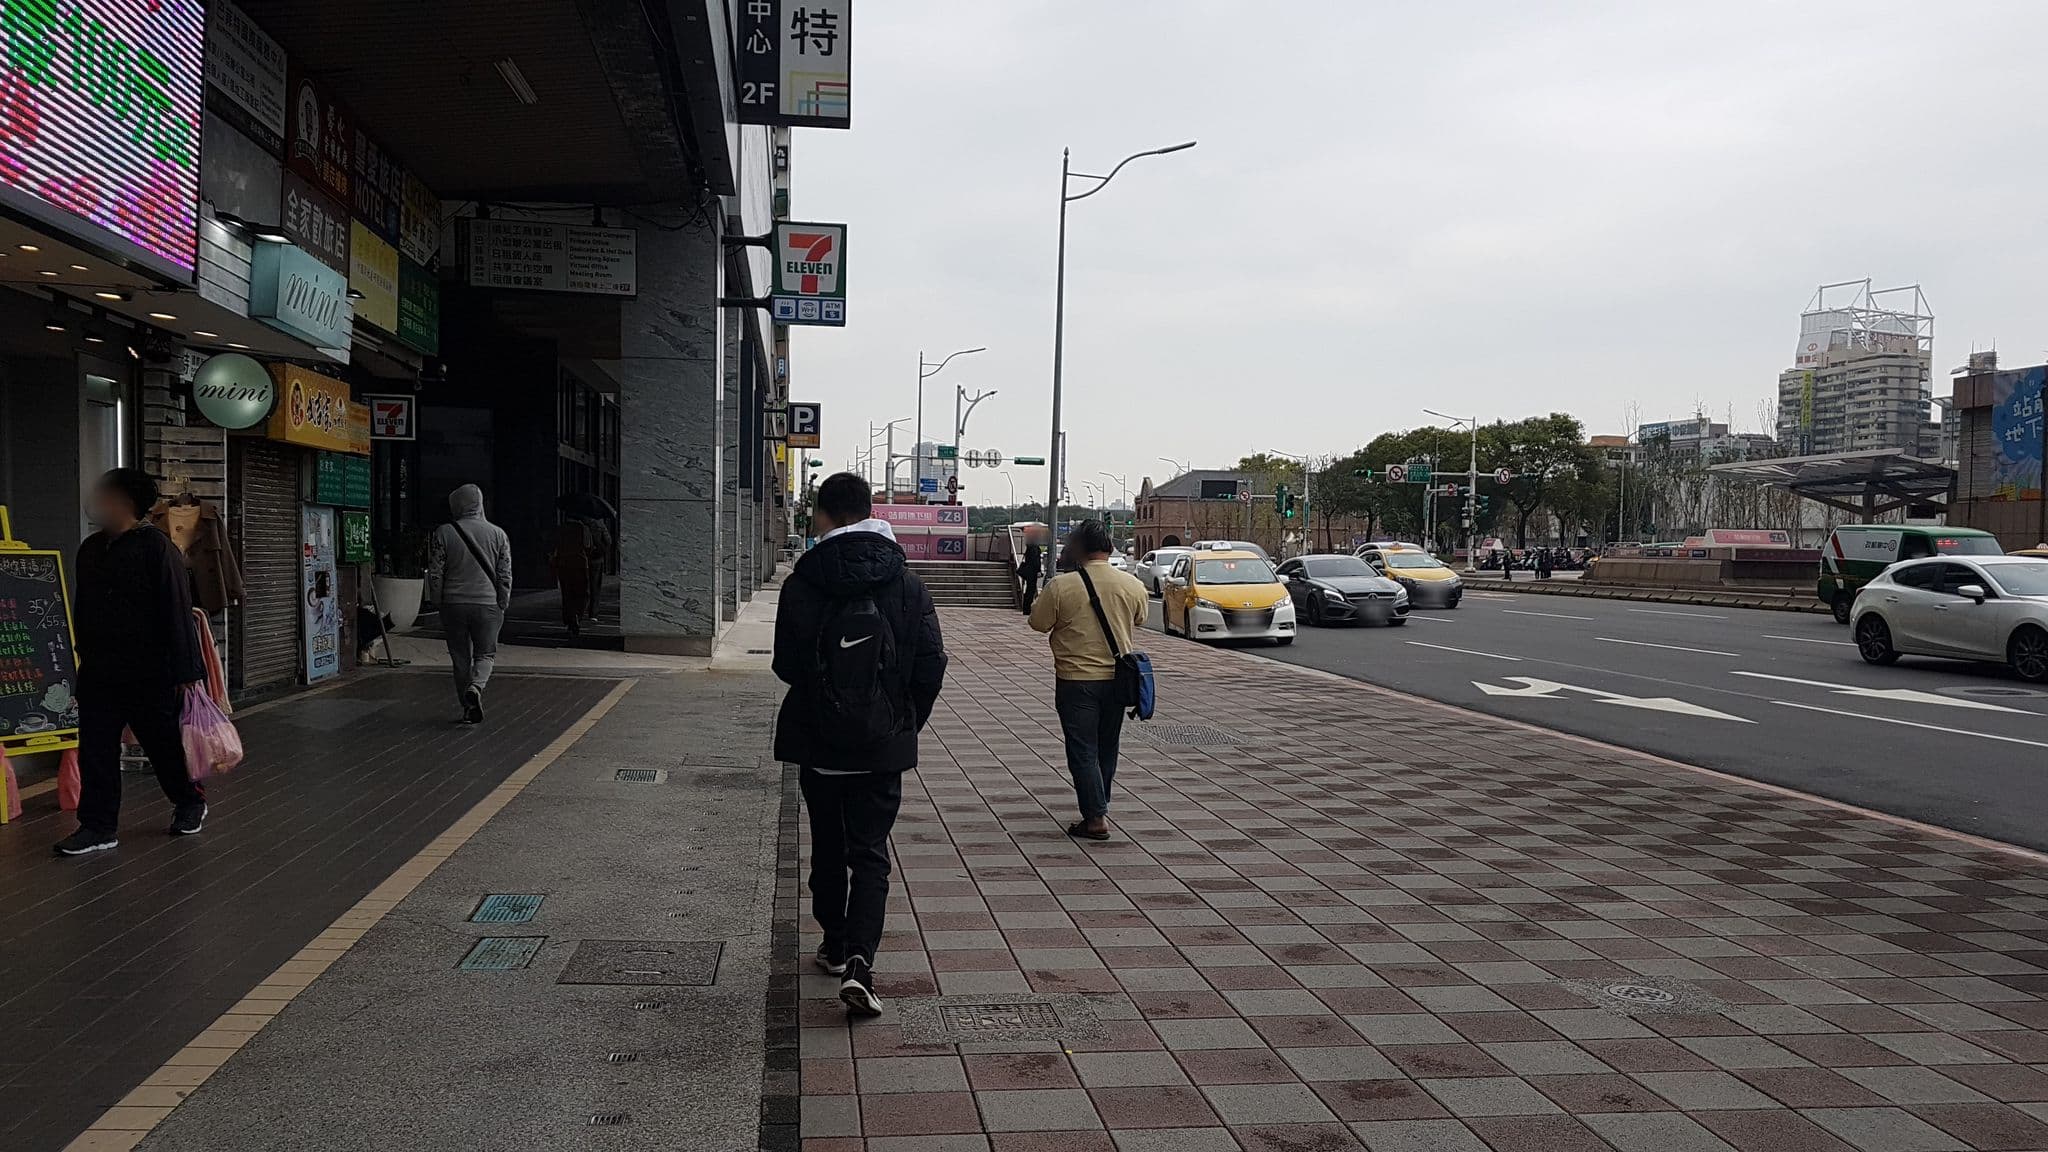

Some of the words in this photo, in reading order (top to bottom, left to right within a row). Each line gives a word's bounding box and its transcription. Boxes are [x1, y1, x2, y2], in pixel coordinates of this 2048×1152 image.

[790, 7, 838, 56] 特
[742, 82, 775, 104] 2F
[355, 174, 385, 228] HOTEL
[286, 272, 339, 330] mini
[199, 381, 269, 403] mini
[793, 406, 815, 433] P
[2005, 416, 2043, 441] 地下
[943, 511, 961, 522] Z8
[943, 541, 961, 552] Z8
